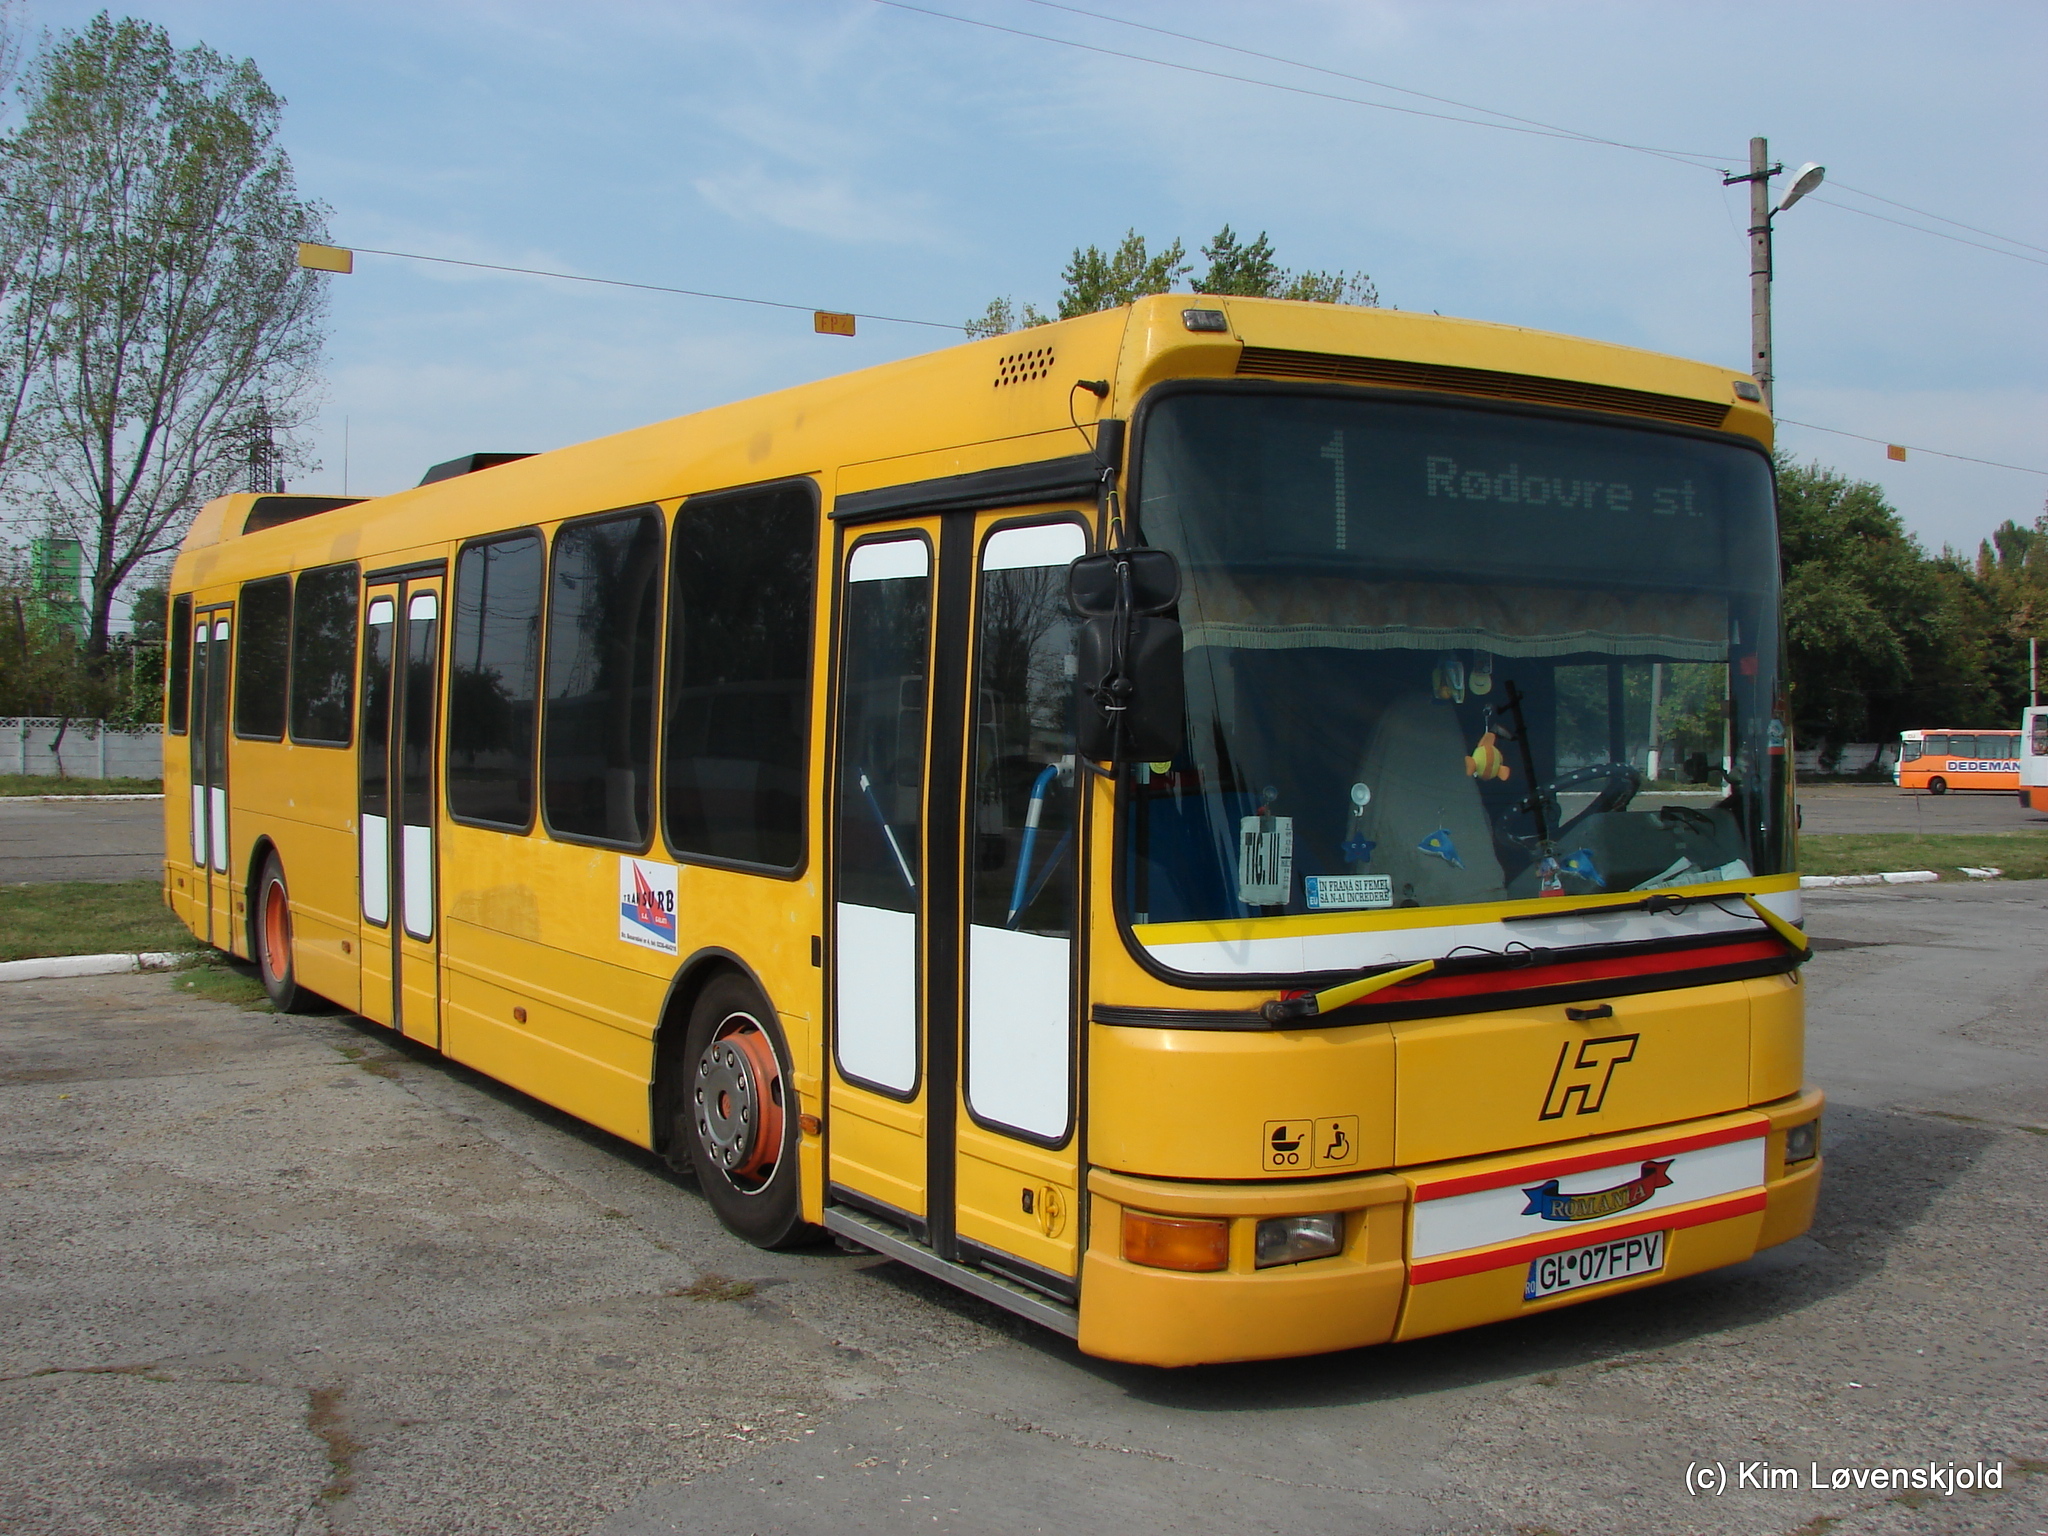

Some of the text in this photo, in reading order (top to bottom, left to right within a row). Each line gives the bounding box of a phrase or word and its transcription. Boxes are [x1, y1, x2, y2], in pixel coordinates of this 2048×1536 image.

[1320, 430, 1347, 550] 1
[623, 889, 674, 912] TRANSURB
[1525, 1280, 1536, 1295] RO
